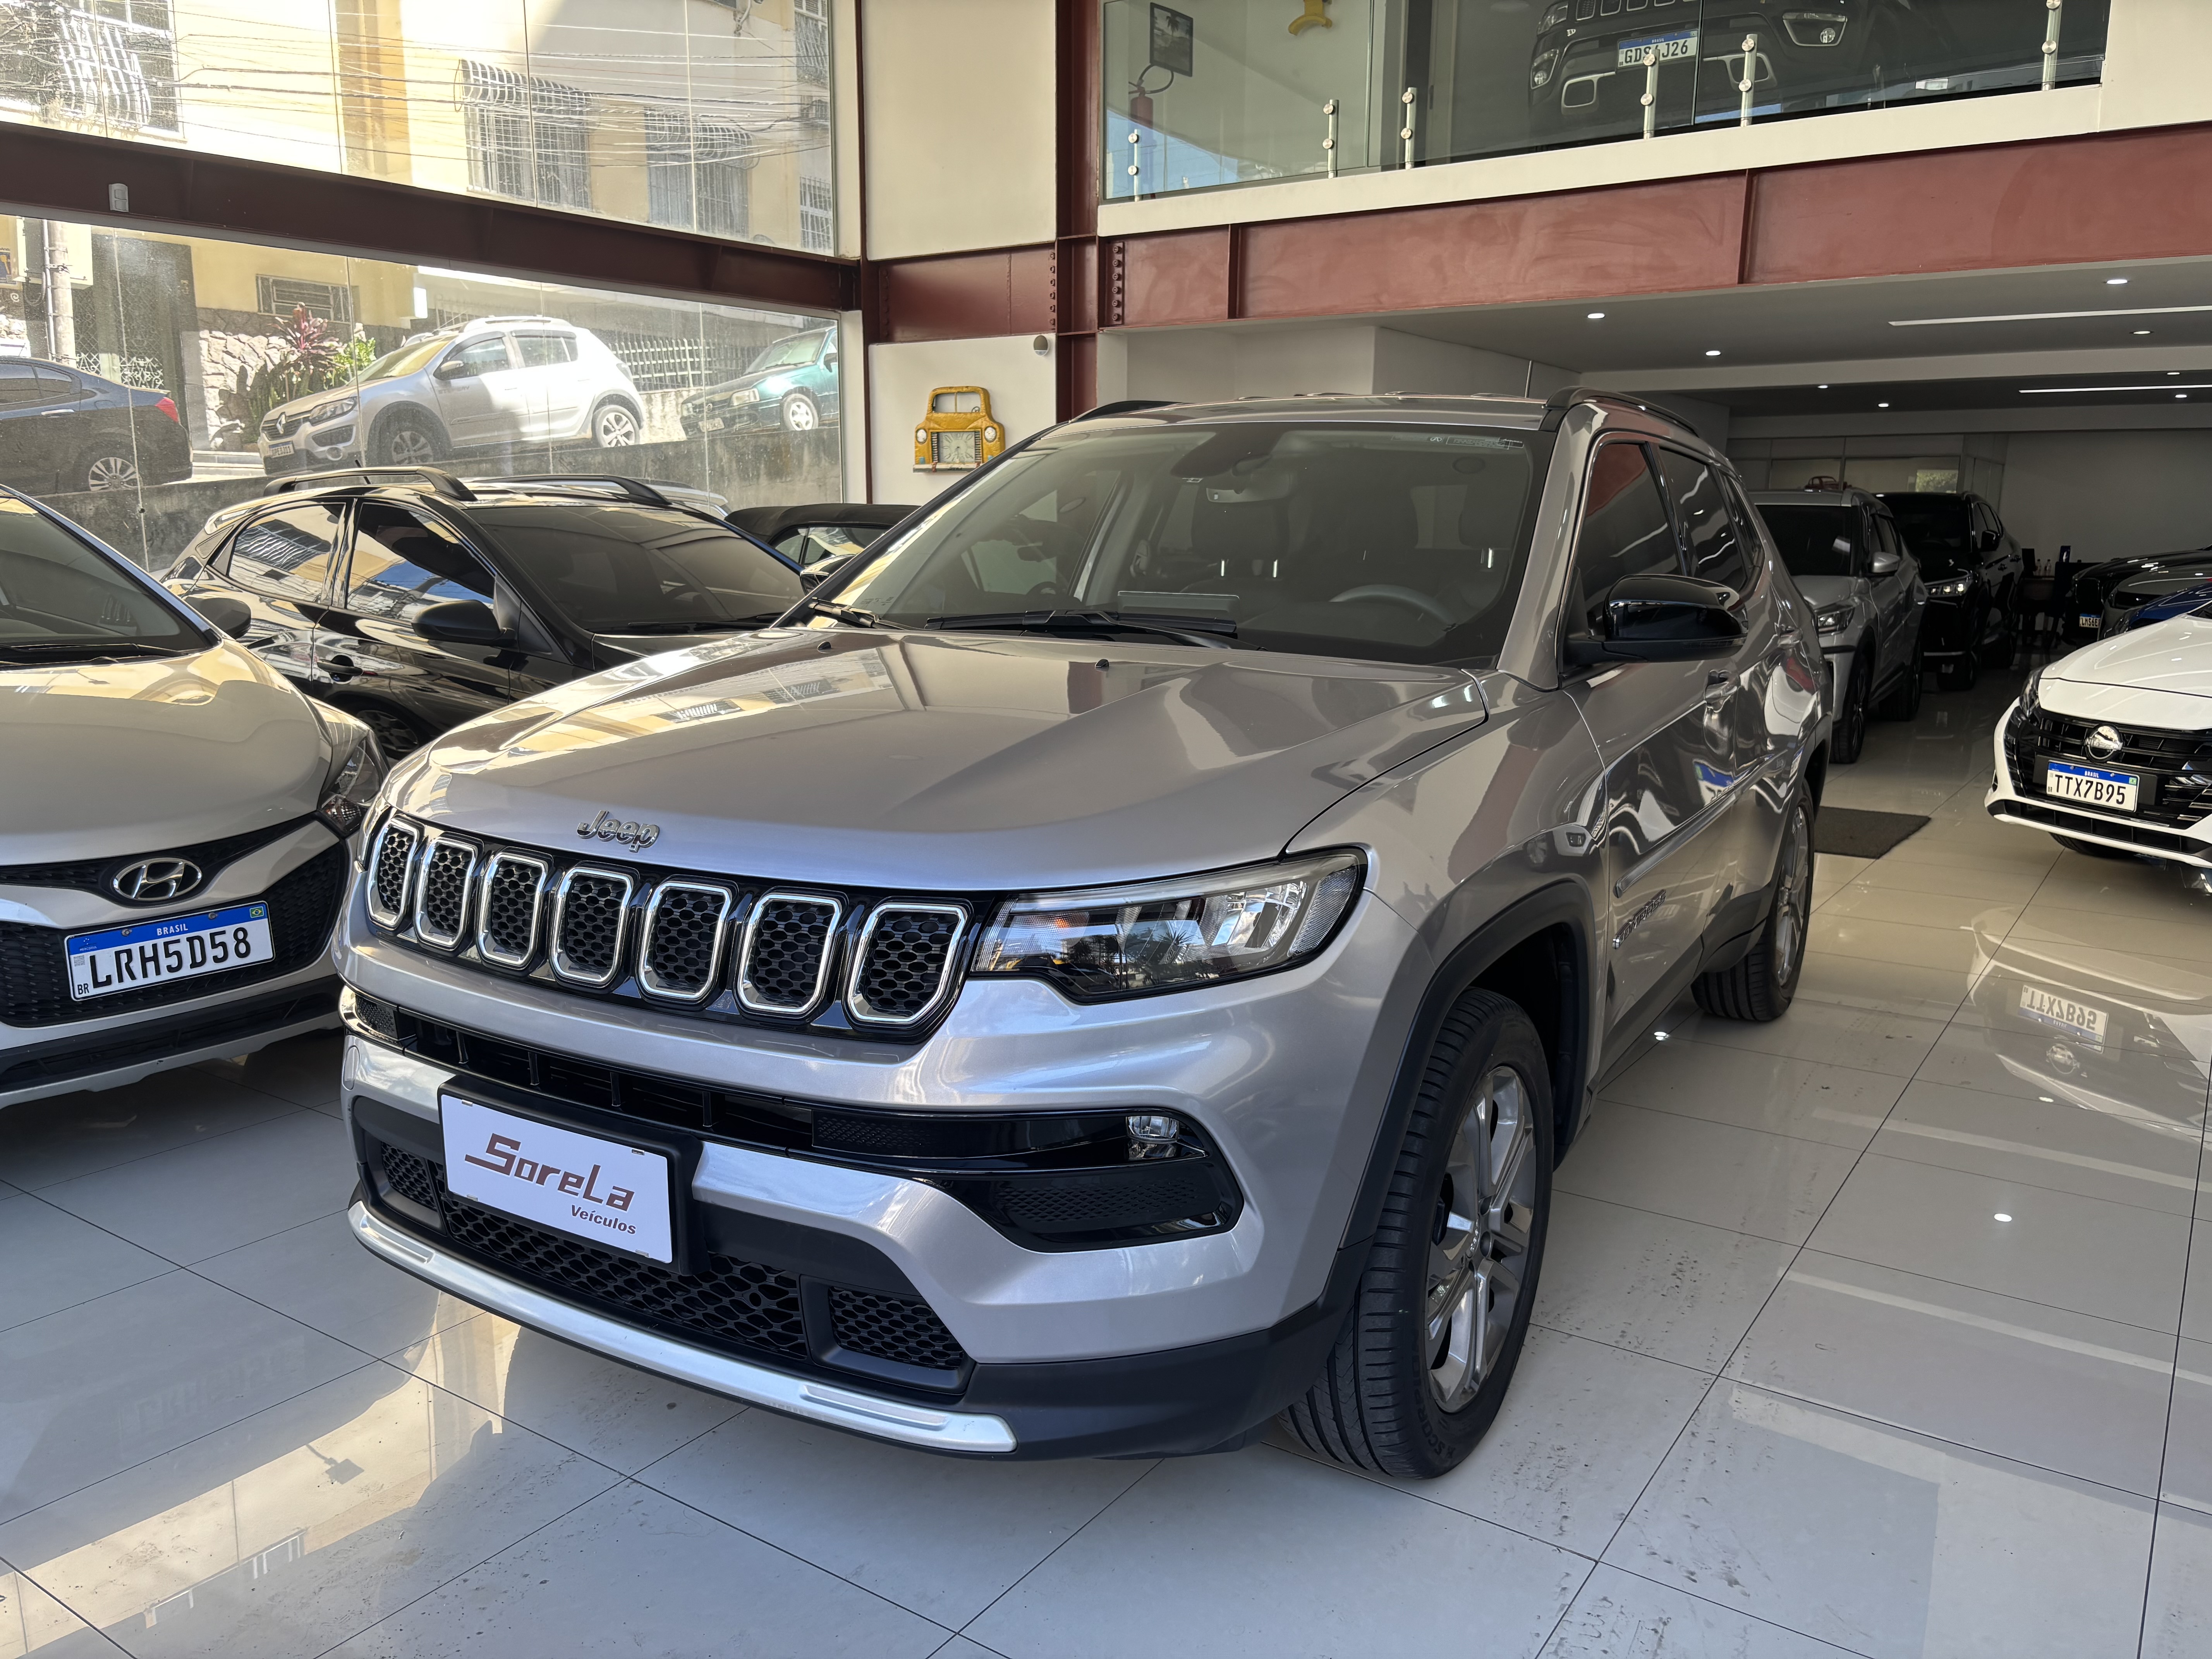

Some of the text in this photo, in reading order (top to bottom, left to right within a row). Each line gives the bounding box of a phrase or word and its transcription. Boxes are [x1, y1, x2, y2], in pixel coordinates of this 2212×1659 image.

[2055, 774, 2126, 805] TTX7B95
[577, 810, 660, 853] Jeep
[156, 923, 189, 936] BRASIL
[1612, 889, 1666, 950] COMPASS
[89, 927, 251, 989] LRH5D58
[77, 983, 89, 995] BR
[571, 1204, 637, 1235] Veículos
